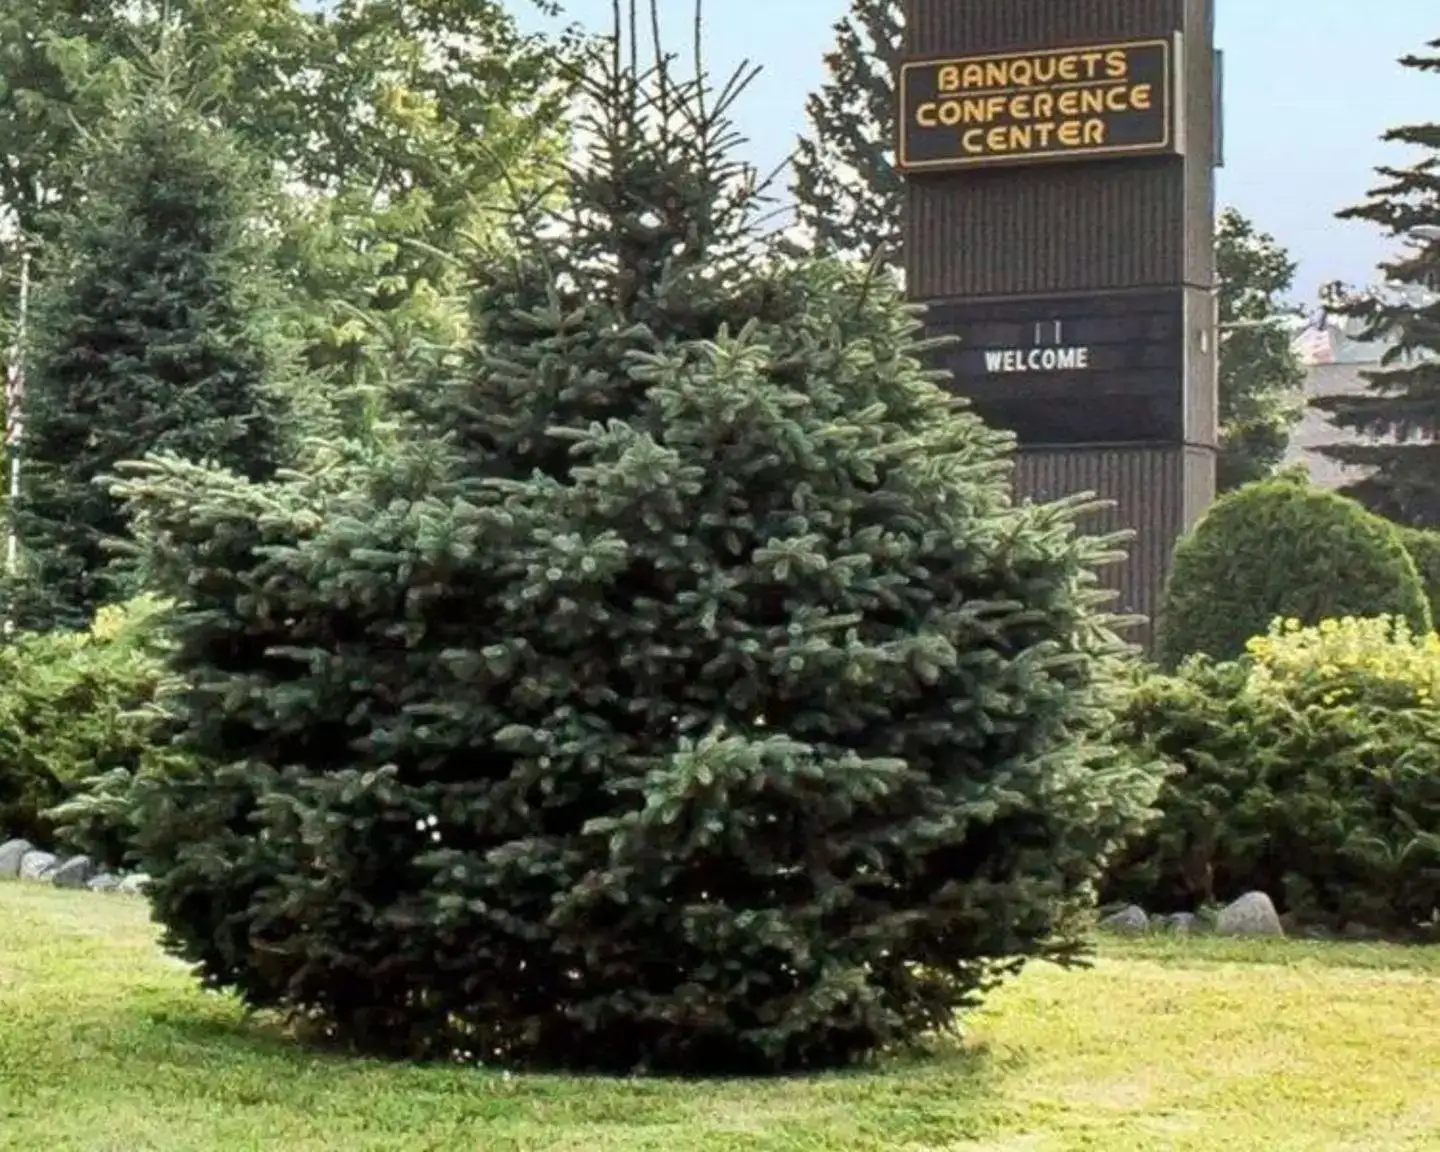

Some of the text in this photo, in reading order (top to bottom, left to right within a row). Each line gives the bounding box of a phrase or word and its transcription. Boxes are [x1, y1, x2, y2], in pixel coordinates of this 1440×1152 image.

[938, 51, 1127, 91] BANQUETS
[916, 84, 1151, 127] CONFERENCE
[962, 118, 1105, 153] CENTER
[985, 347, 1088, 372] WELCOME
